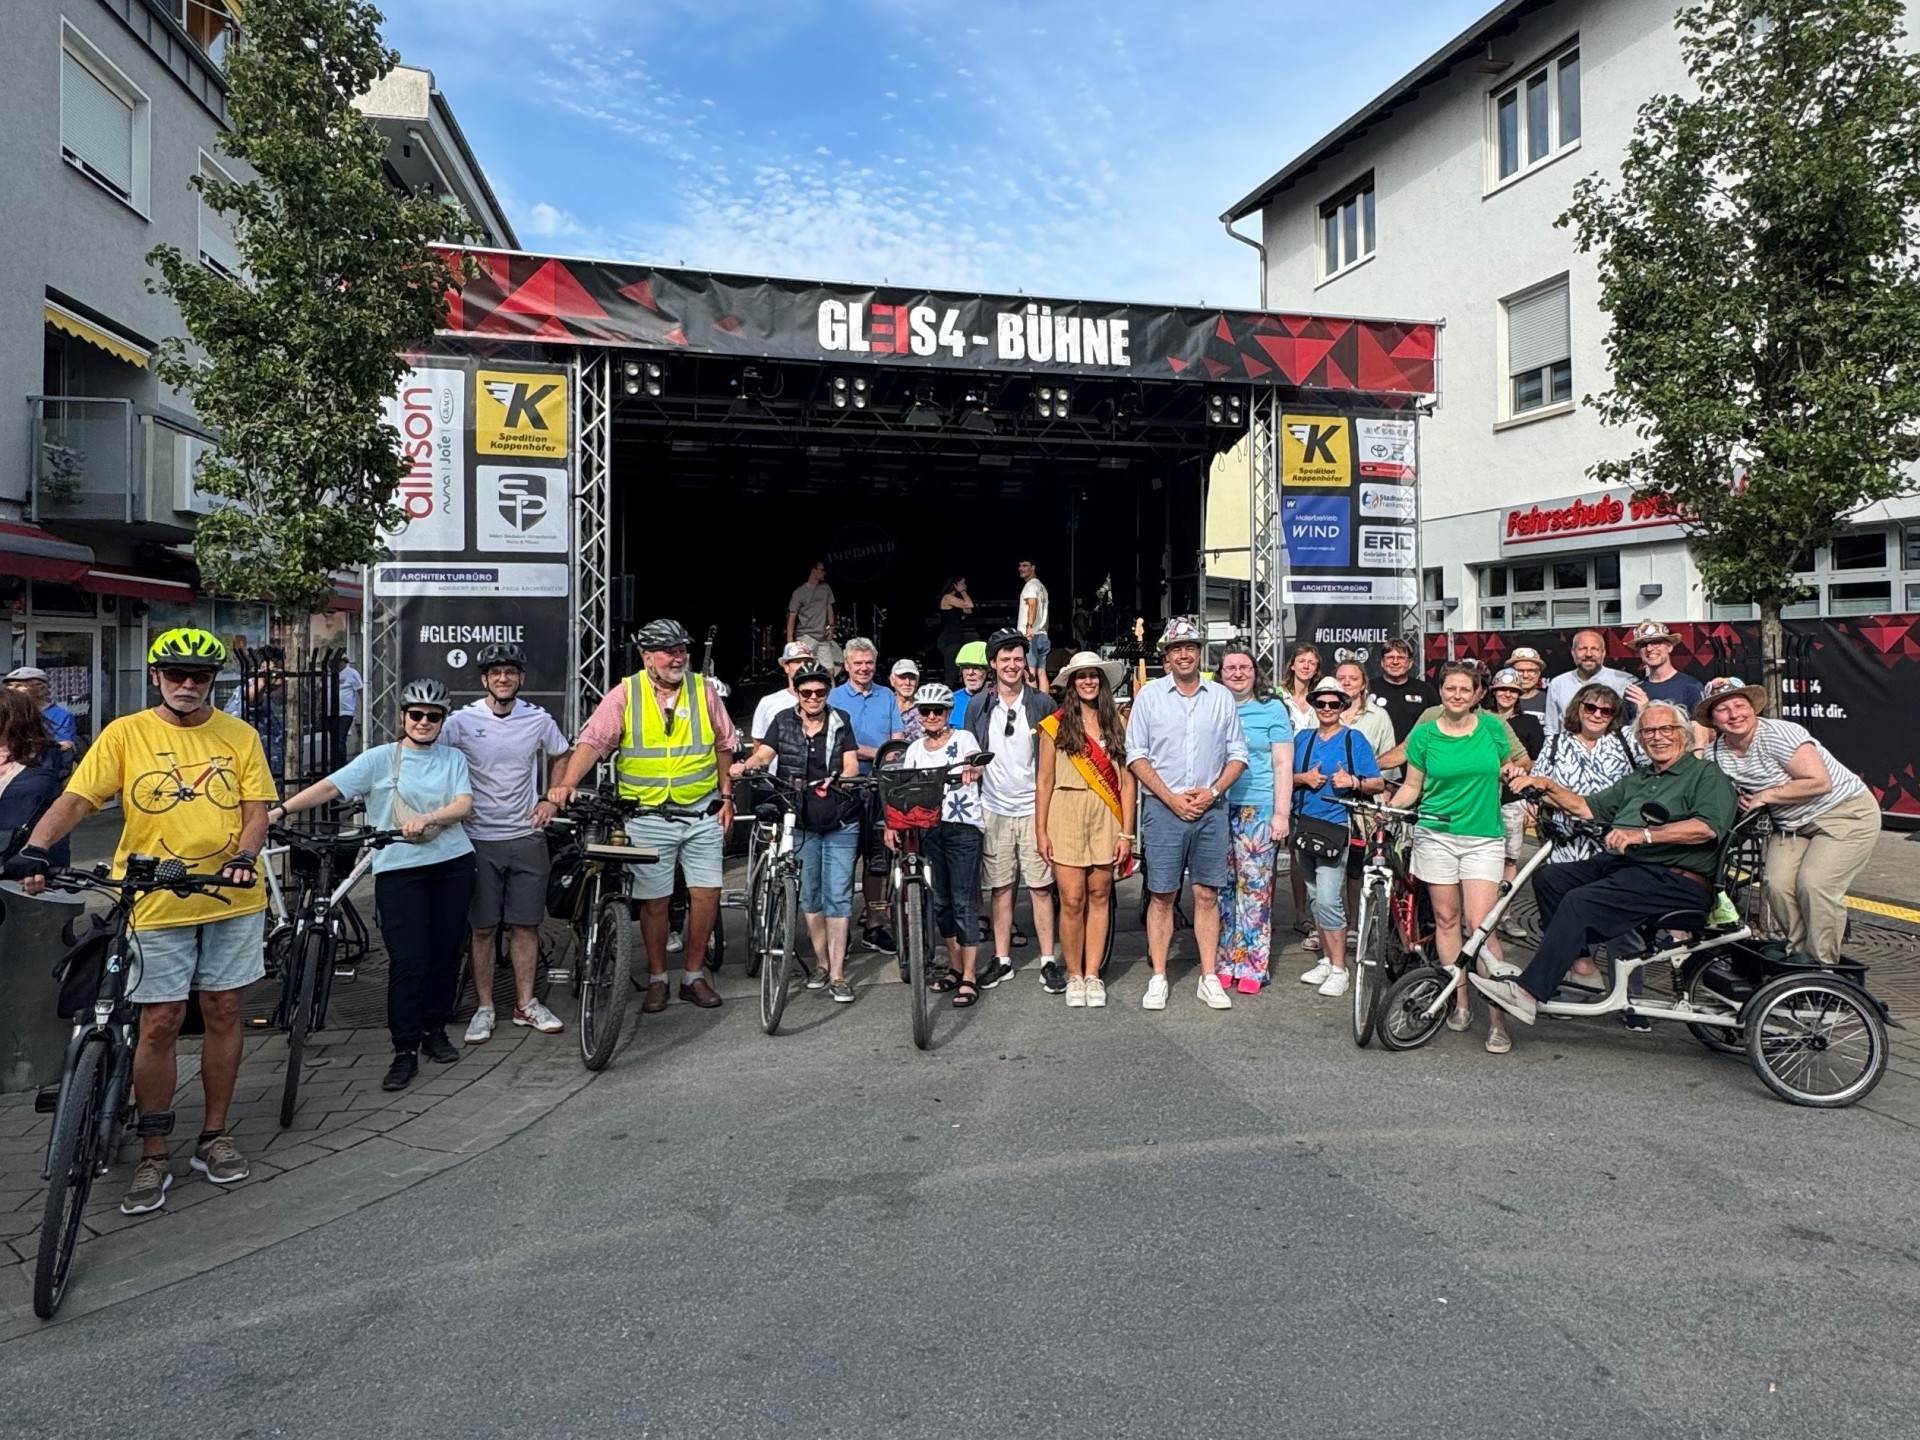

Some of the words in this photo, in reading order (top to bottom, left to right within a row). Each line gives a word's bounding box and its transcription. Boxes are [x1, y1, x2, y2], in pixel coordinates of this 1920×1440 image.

[499, 432, 548, 443] Spedition
[437, 434, 451, 464] Joie
[490, 441, 556, 453] Koppenhöfer
[1299, 467, 1336, 475] Spedition
[1292, 474, 1343, 483] Koppenhöfer
[1295, 514, 1338, 522] Malerbetrieb
[1506, 493, 1625, 537] Fahrschule
[1292, 525, 1340, 538] WIND
[1364, 531, 1412, 550] ERTL
[827, 541, 896, 563] IMPROVED
[401, 572, 492, 582] ARCHITEKTURBÜRO
[1302, 583, 1368, 592] ARCHITEKTURBÜRO
[419, 625, 524, 643] #GLEIS4MEILE
[1315, 628, 1389, 644] #GLEIS4MEILE
[1826, 704, 1847, 718] dir.
